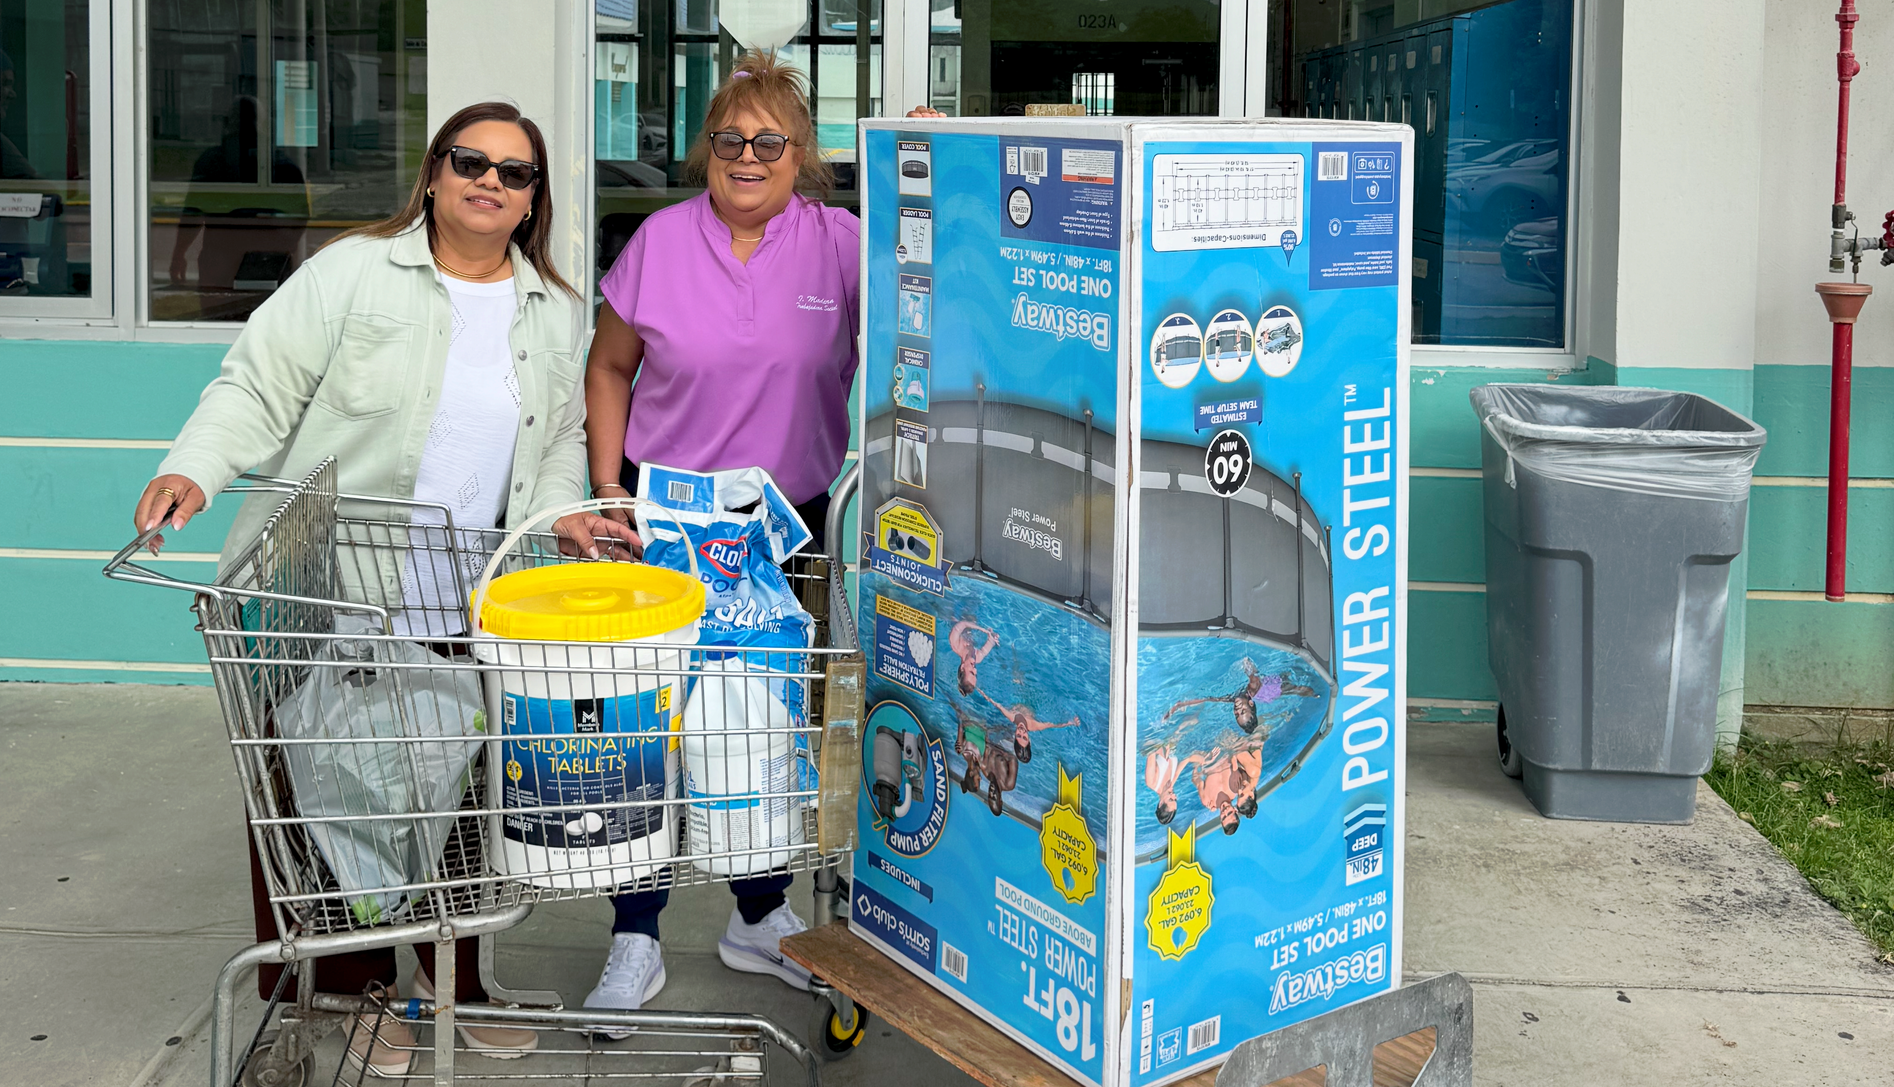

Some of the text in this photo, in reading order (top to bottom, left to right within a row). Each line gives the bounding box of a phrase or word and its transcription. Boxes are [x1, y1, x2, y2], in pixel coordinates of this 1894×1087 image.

[1078, 14, 1117, 29] 023A
[1011, 205, 1029, 213] ASSEMBLY
[1015, 213, 1024, 221] EASY
[1191, 232, 1266, 243] Dimensions-Capacities:
[1000, 246, 1024, 261] 1.22M
[1030, 250, 1056, 265] 5.49M
[1063, 254, 1084, 268] 48IN.
[1092, 258, 1112, 272] 18FT.
[901, 283, 929, 293] MAINTENANCE
[1012, 265, 1112, 299] ONE POOL SET
[1011, 292, 1111, 352] Bestway
[1199, 399, 1257, 415] TEAM SETUP TIME
[1210, 411, 1247, 425] ESTIMATED
[1219, 440, 1237, 452] MIN
[1212, 453, 1243, 485] 60
[1031, 513, 1056, 532] Power
[1001, 518, 1062, 561] Bestway
[890, 554, 921, 571] JOINTS
[700, 619, 722, 630] AST
[883, 653, 925, 678] FILTRATION BALLS
[1342, 585, 1390, 793] POWER
[660, 696, 667, 707] 2
[516, 726, 658, 757] CHLORINAING
[547, 752, 627, 774] TABLETS
[890, 750, 945, 852] SAND FILTER PUMP
[1051, 825, 1087, 852] CAPACITY
[1351, 831, 1378, 852] DEEP
[1050, 846, 1088, 876] 6,092 GAL.
[1061, 840, 1081, 860] 23,062
[880, 858, 920, 891] INCLUDES
[1349, 855, 1379, 880] 48IN.
[1160, 884, 1200, 907] CAPACITY
[1172, 899, 1194, 912] 23,062
[1365, 889, 1387, 905] 18FT.
[999, 883, 1092, 949] ABOVE GROUND POOL
[1158, 906, 1202, 928] 6,092 GAL.
[1332, 900, 1357, 920] 48IN.
[872, 904, 930, 952] sam's club
[1293, 911, 1323, 934] 5.49M
[1254, 923, 1285, 948] 1.22M
[1269, 910, 1387, 970] ONE POOL SET
[1044, 933, 1096, 998] POWER
[1268, 942, 1386, 1016] Bestway
[1021, 960, 1096, 1062] 18FT.
